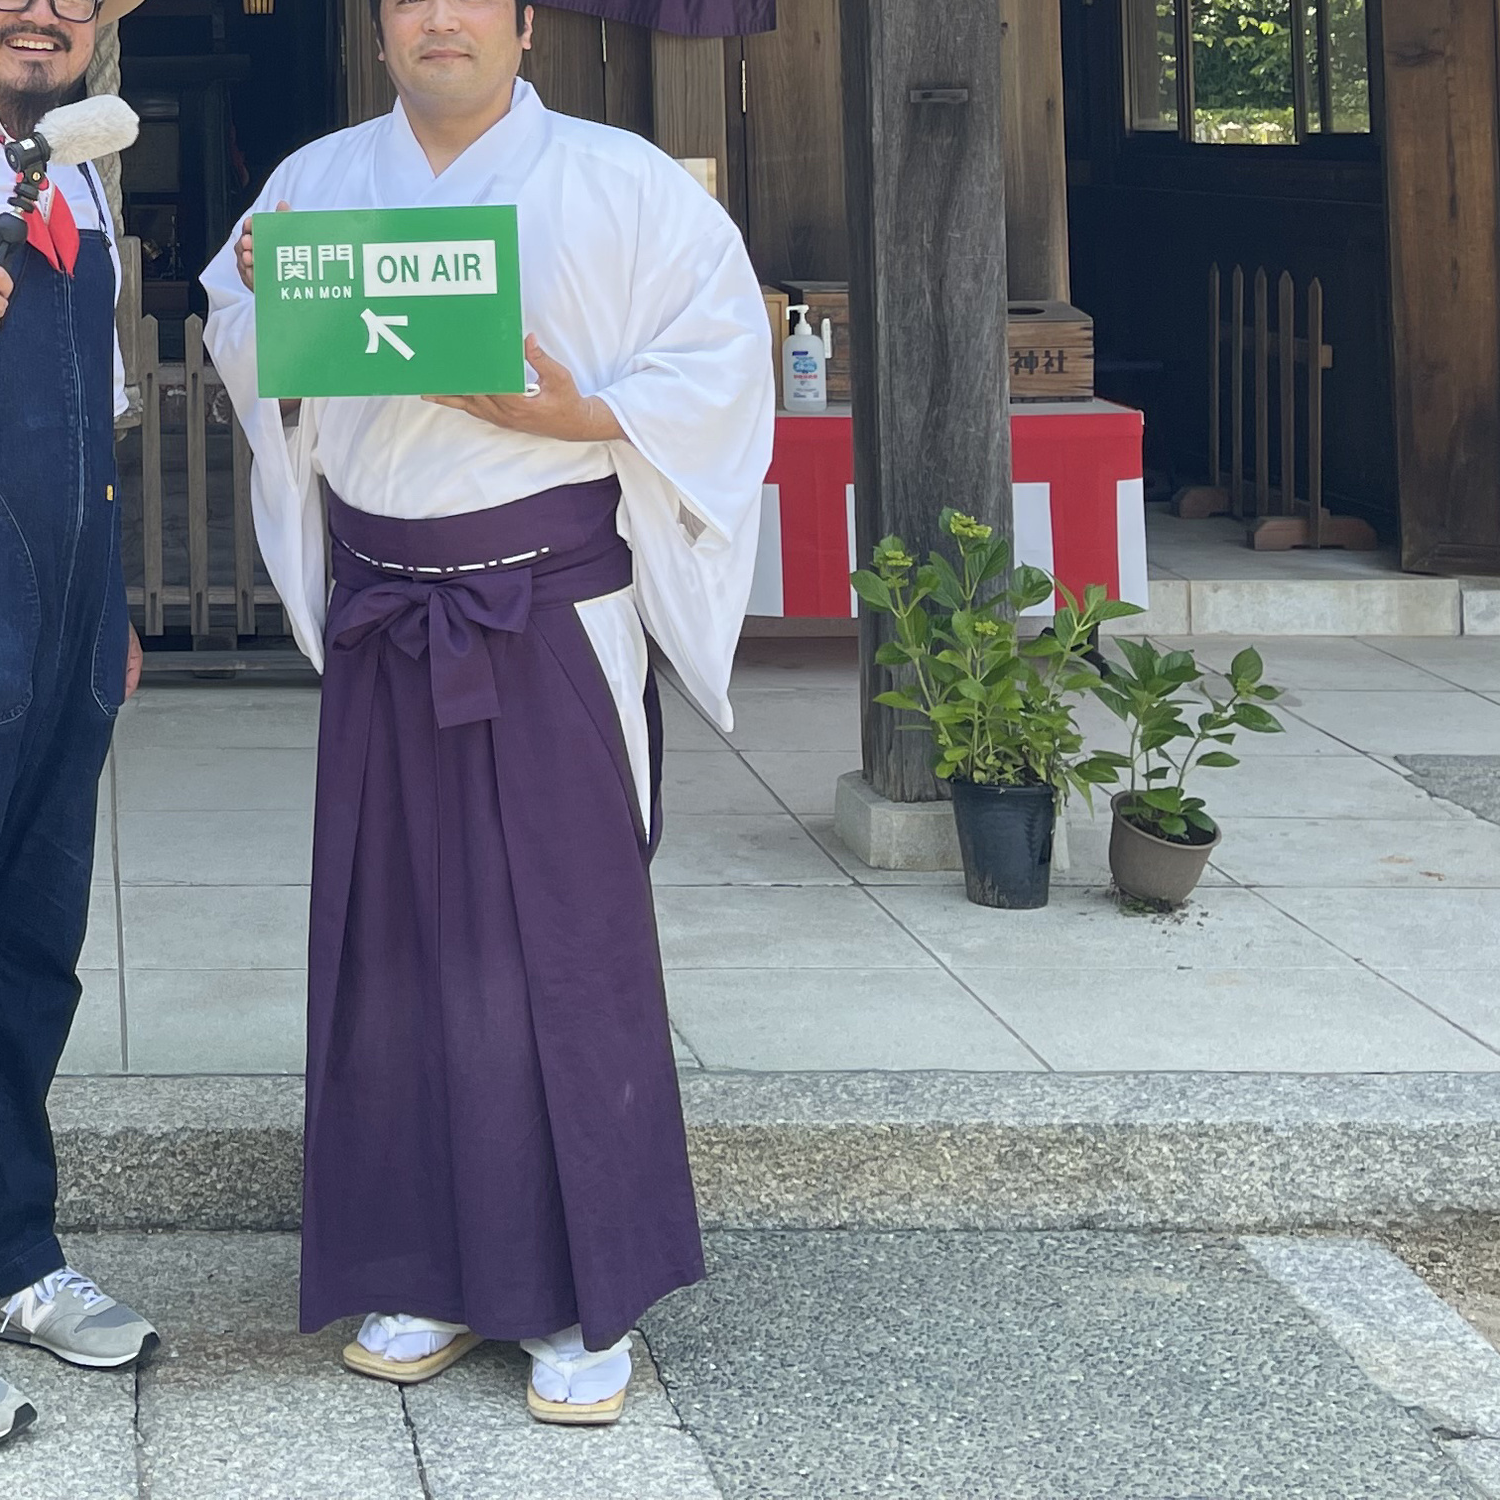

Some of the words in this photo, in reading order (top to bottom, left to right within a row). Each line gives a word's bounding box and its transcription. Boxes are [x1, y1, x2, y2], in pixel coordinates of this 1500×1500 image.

[276, 244, 354, 281] 関門
[376, 255, 420, 284] ON
[431, 253, 482, 282] AIR
[1010, 350, 1069, 375] 神社
